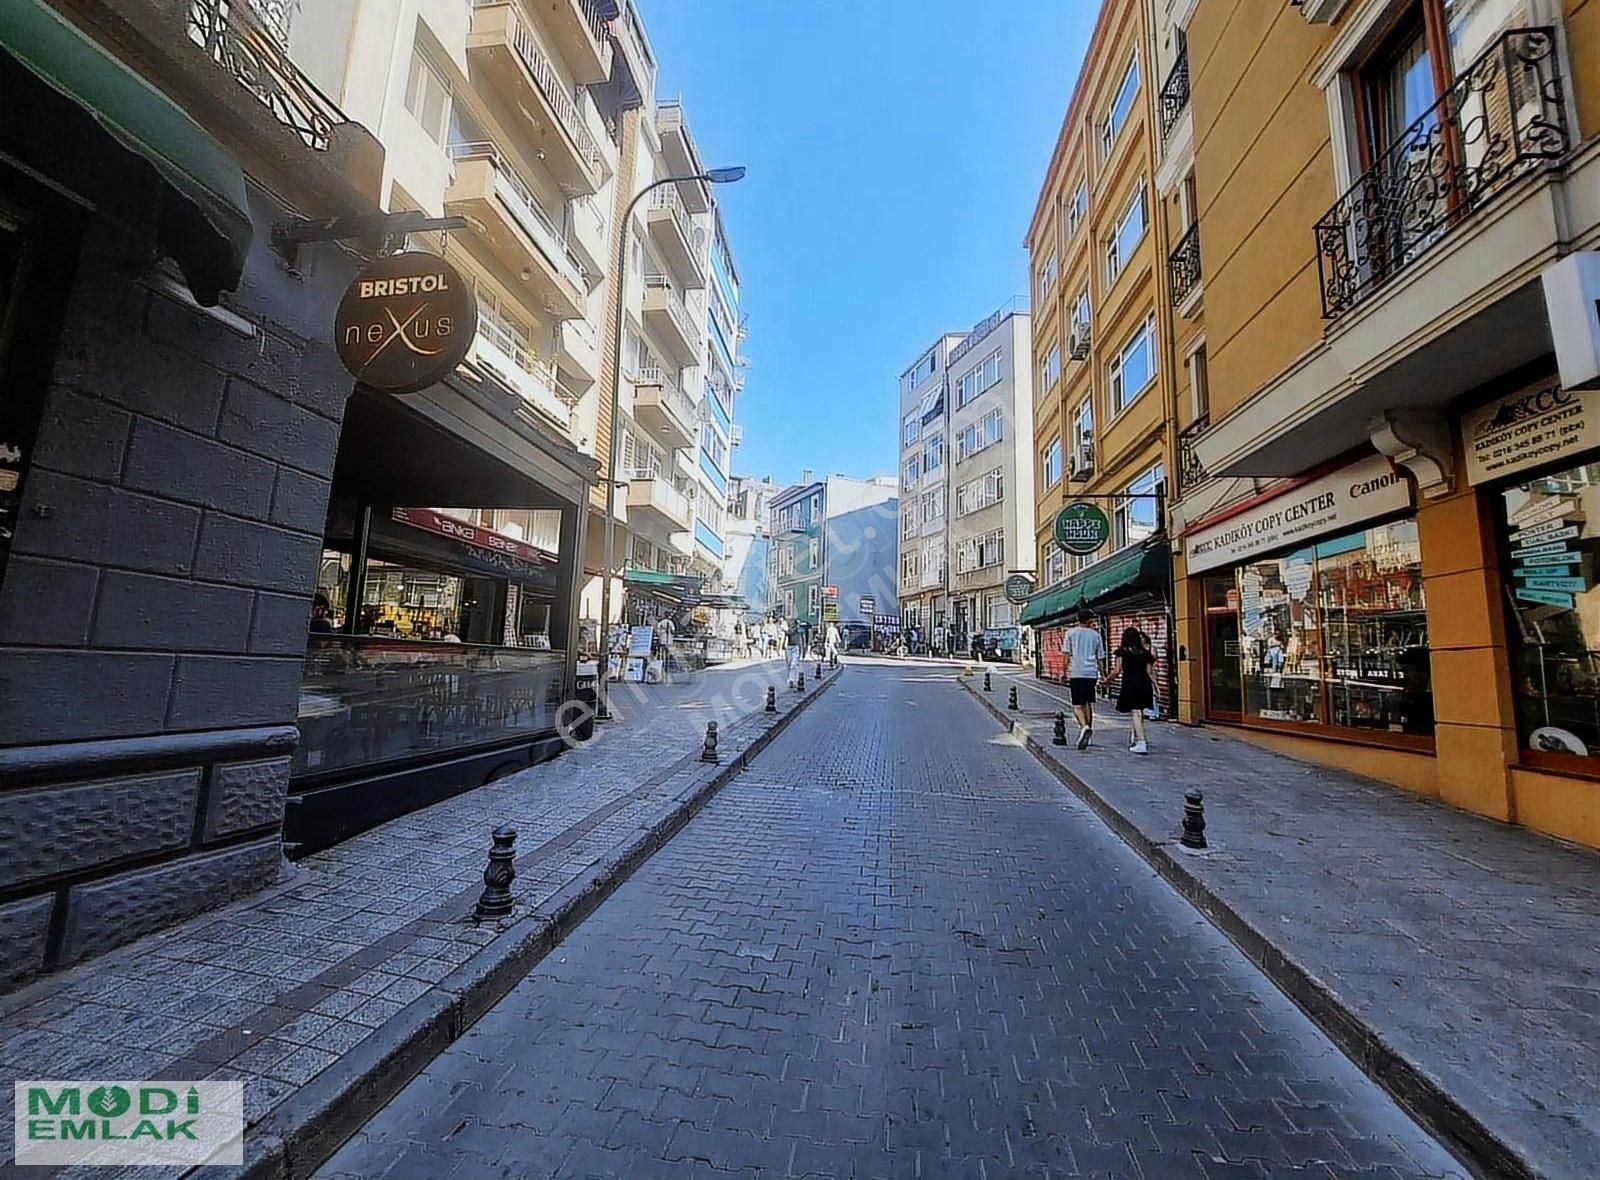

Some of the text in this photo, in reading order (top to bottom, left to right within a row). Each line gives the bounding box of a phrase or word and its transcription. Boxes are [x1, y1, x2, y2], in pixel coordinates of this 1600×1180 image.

[360, 274, 449, 298] BRISTOL
[1514, 420, 1539, 437] COPY
[1541, 405, 1584, 426] CENTER
[1255, 511, 1283, 534] COPY
[1284, 491, 1336, 522] CENTER
[1349, 472, 1400, 498] Canon
